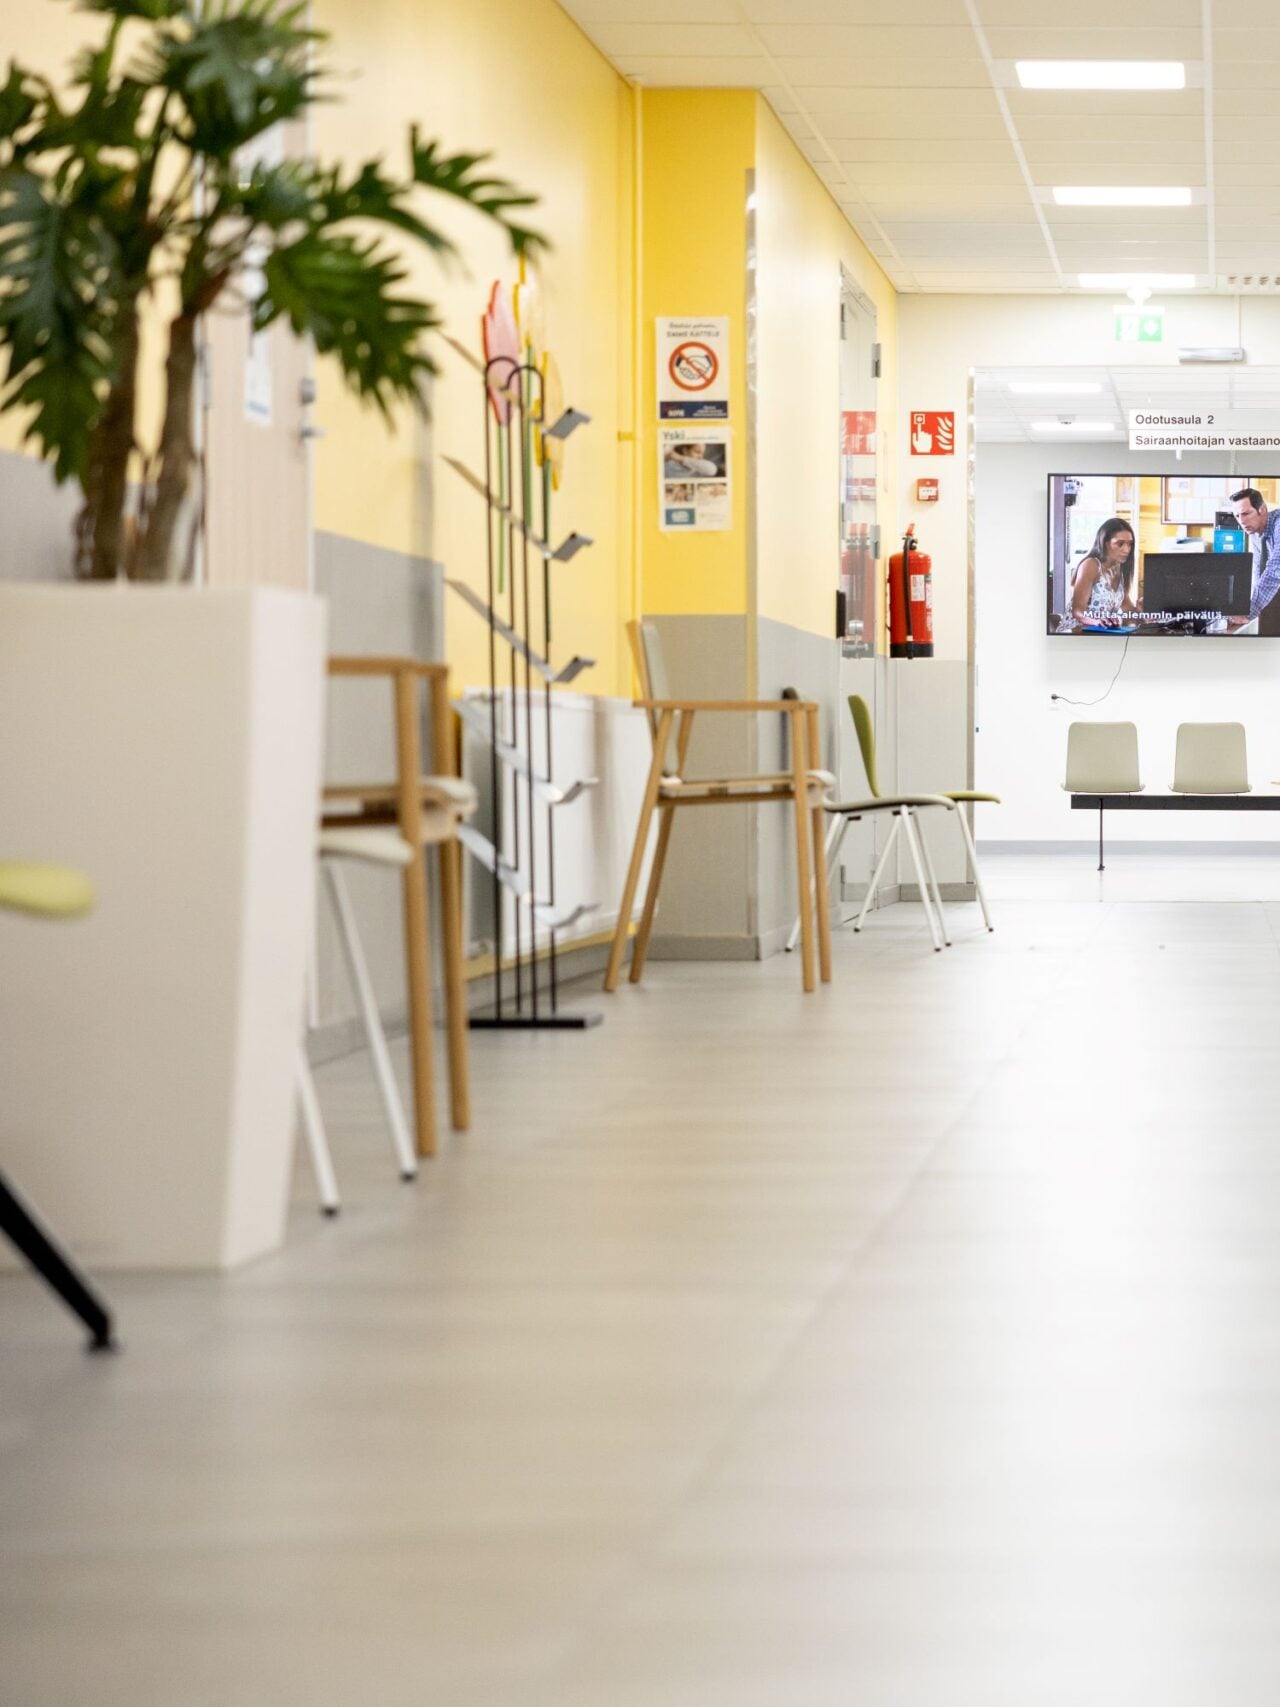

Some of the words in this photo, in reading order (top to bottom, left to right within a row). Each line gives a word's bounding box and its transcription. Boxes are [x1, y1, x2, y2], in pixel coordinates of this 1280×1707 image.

[1135, 414, 1202, 425] Odotusaula
[1207, 415, 1214, 425] 2
[1135, 435, 1225, 448] Sairaanhoitajan
[1083, 610, 1117, 619] Mutta
